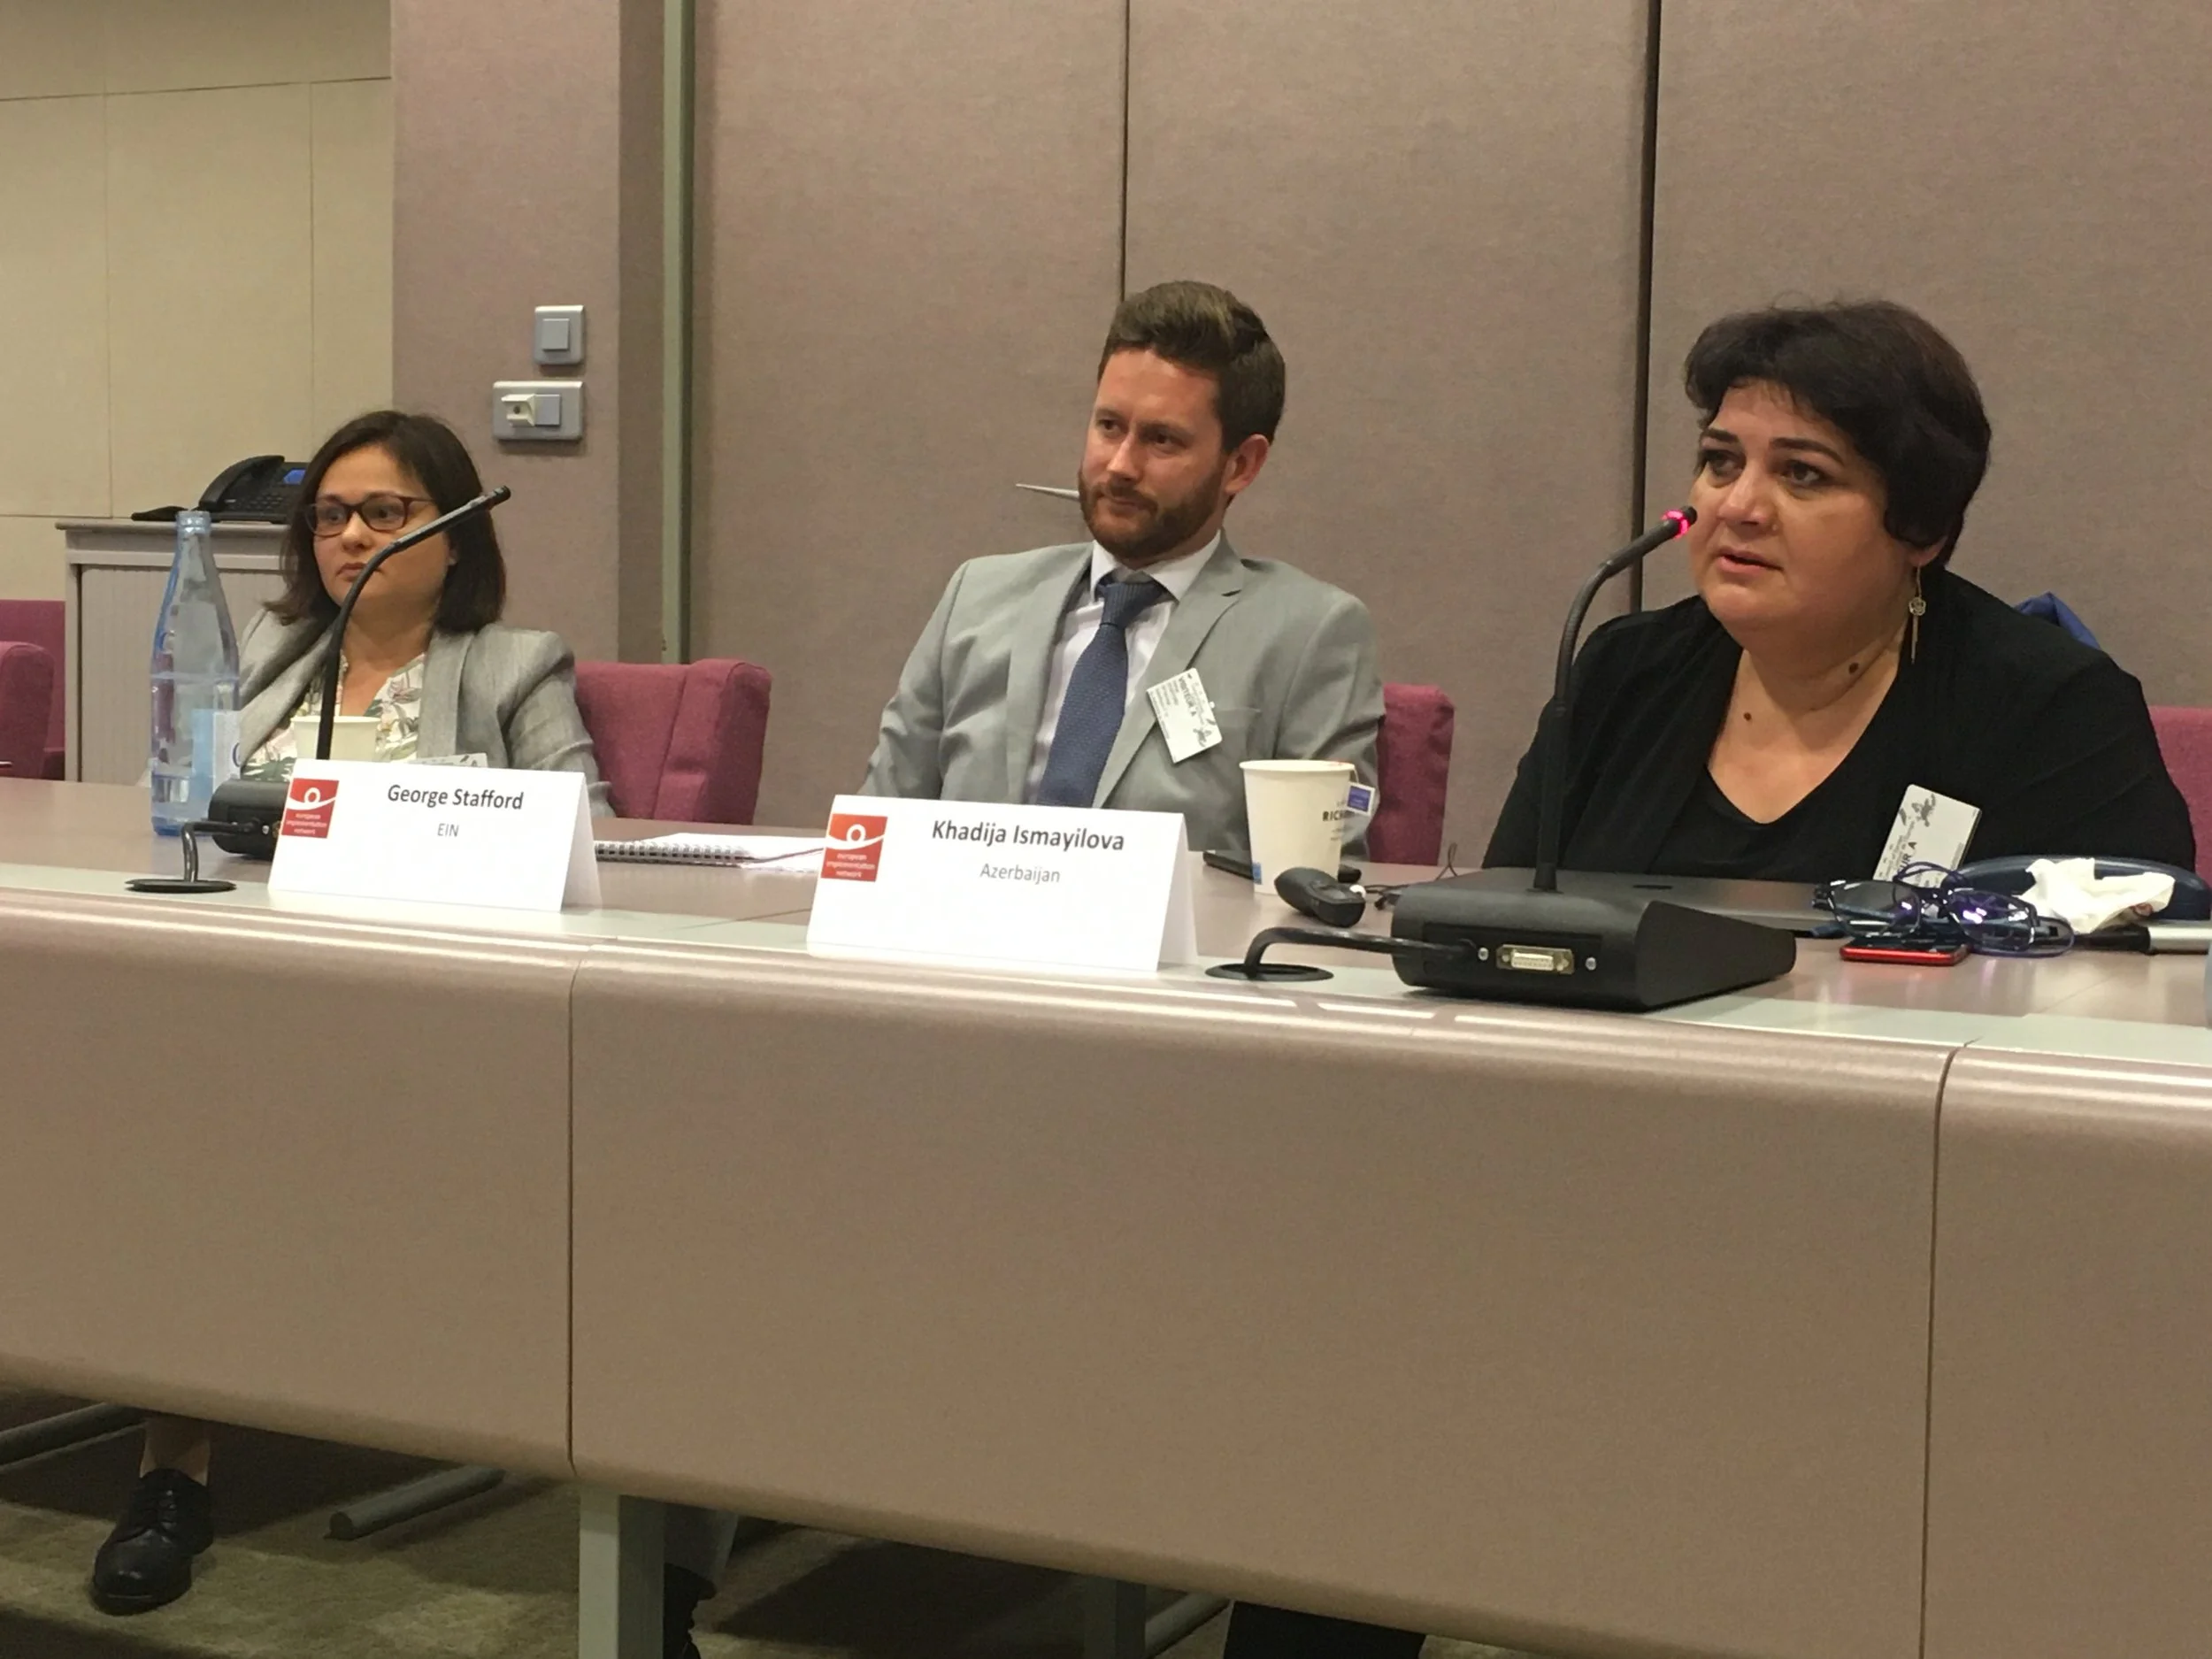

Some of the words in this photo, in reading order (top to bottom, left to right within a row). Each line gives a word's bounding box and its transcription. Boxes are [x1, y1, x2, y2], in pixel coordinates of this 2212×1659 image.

[388, 784, 448, 808] George
[452, 788, 524, 810] Stafford
[437, 823, 459, 837] EIN
[932, 819, 1006, 847] Khadija
[1012, 825, 1125, 851] Ismayilova
[979, 862, 1060, 885] Azerbaijan
